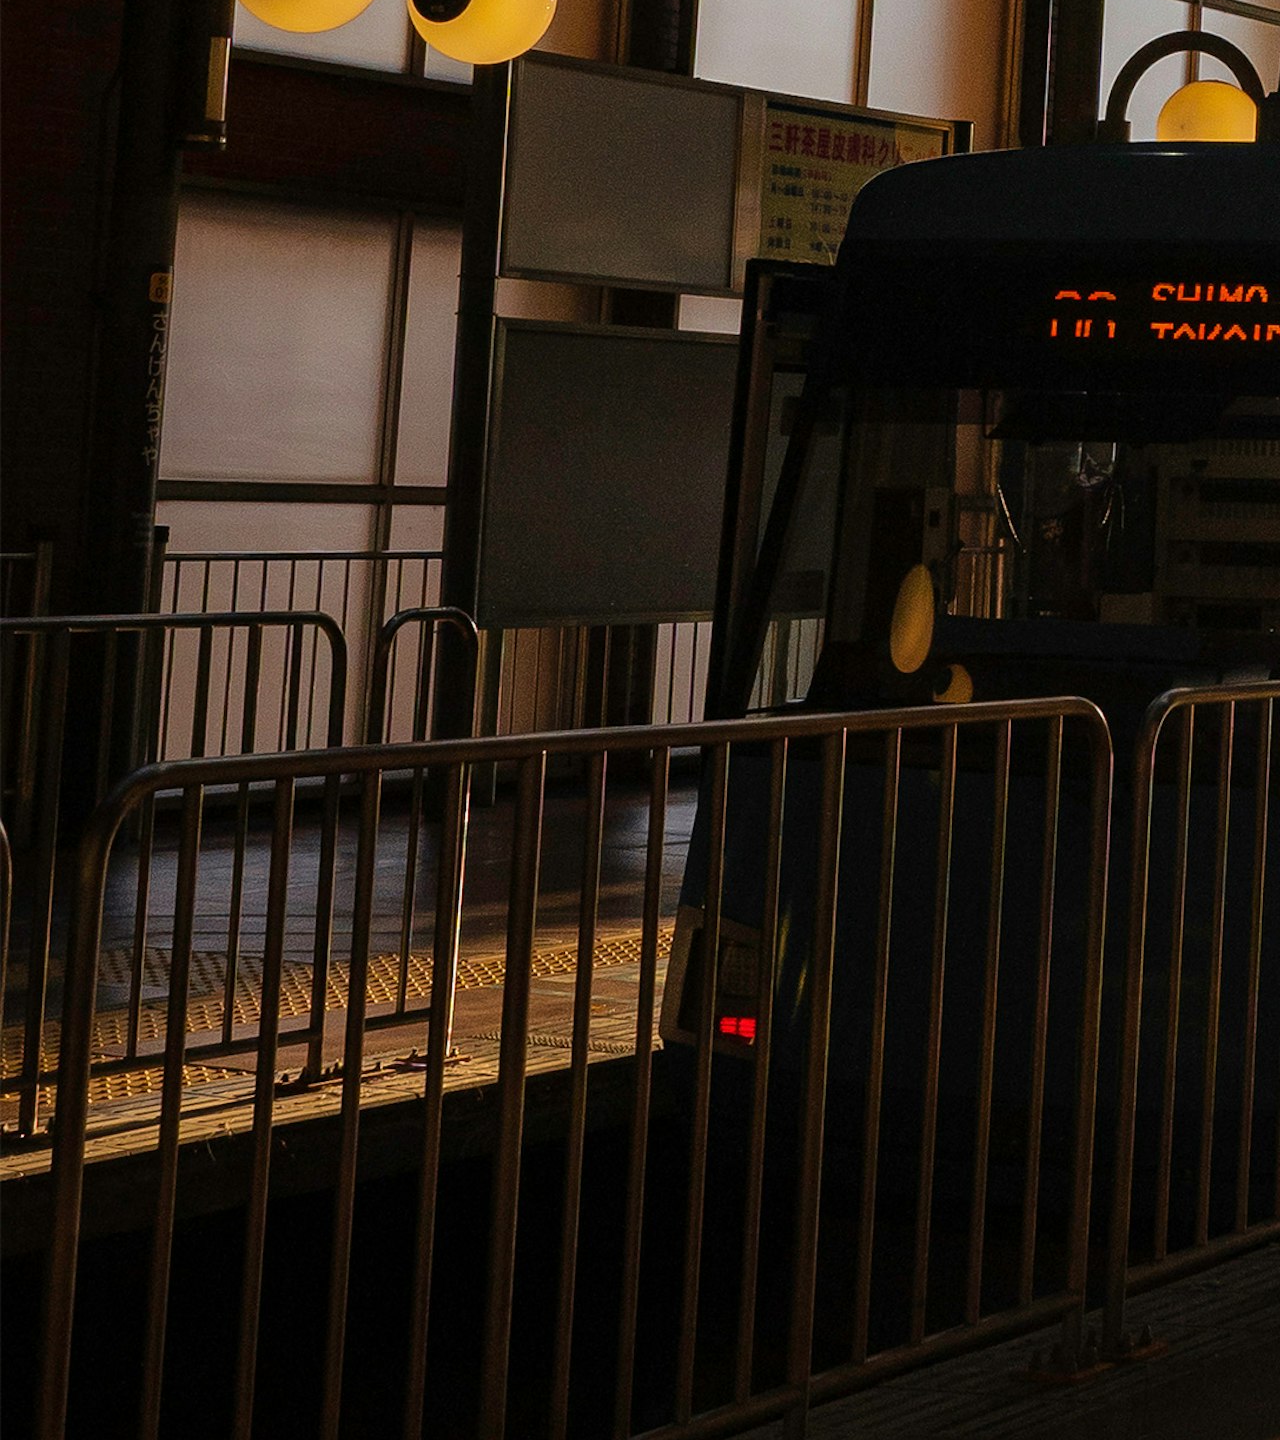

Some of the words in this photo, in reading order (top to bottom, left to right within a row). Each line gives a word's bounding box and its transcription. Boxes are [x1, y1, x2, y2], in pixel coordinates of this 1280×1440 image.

[768, 121, 936, 166] 三軒茶屋皮膚科クリ
